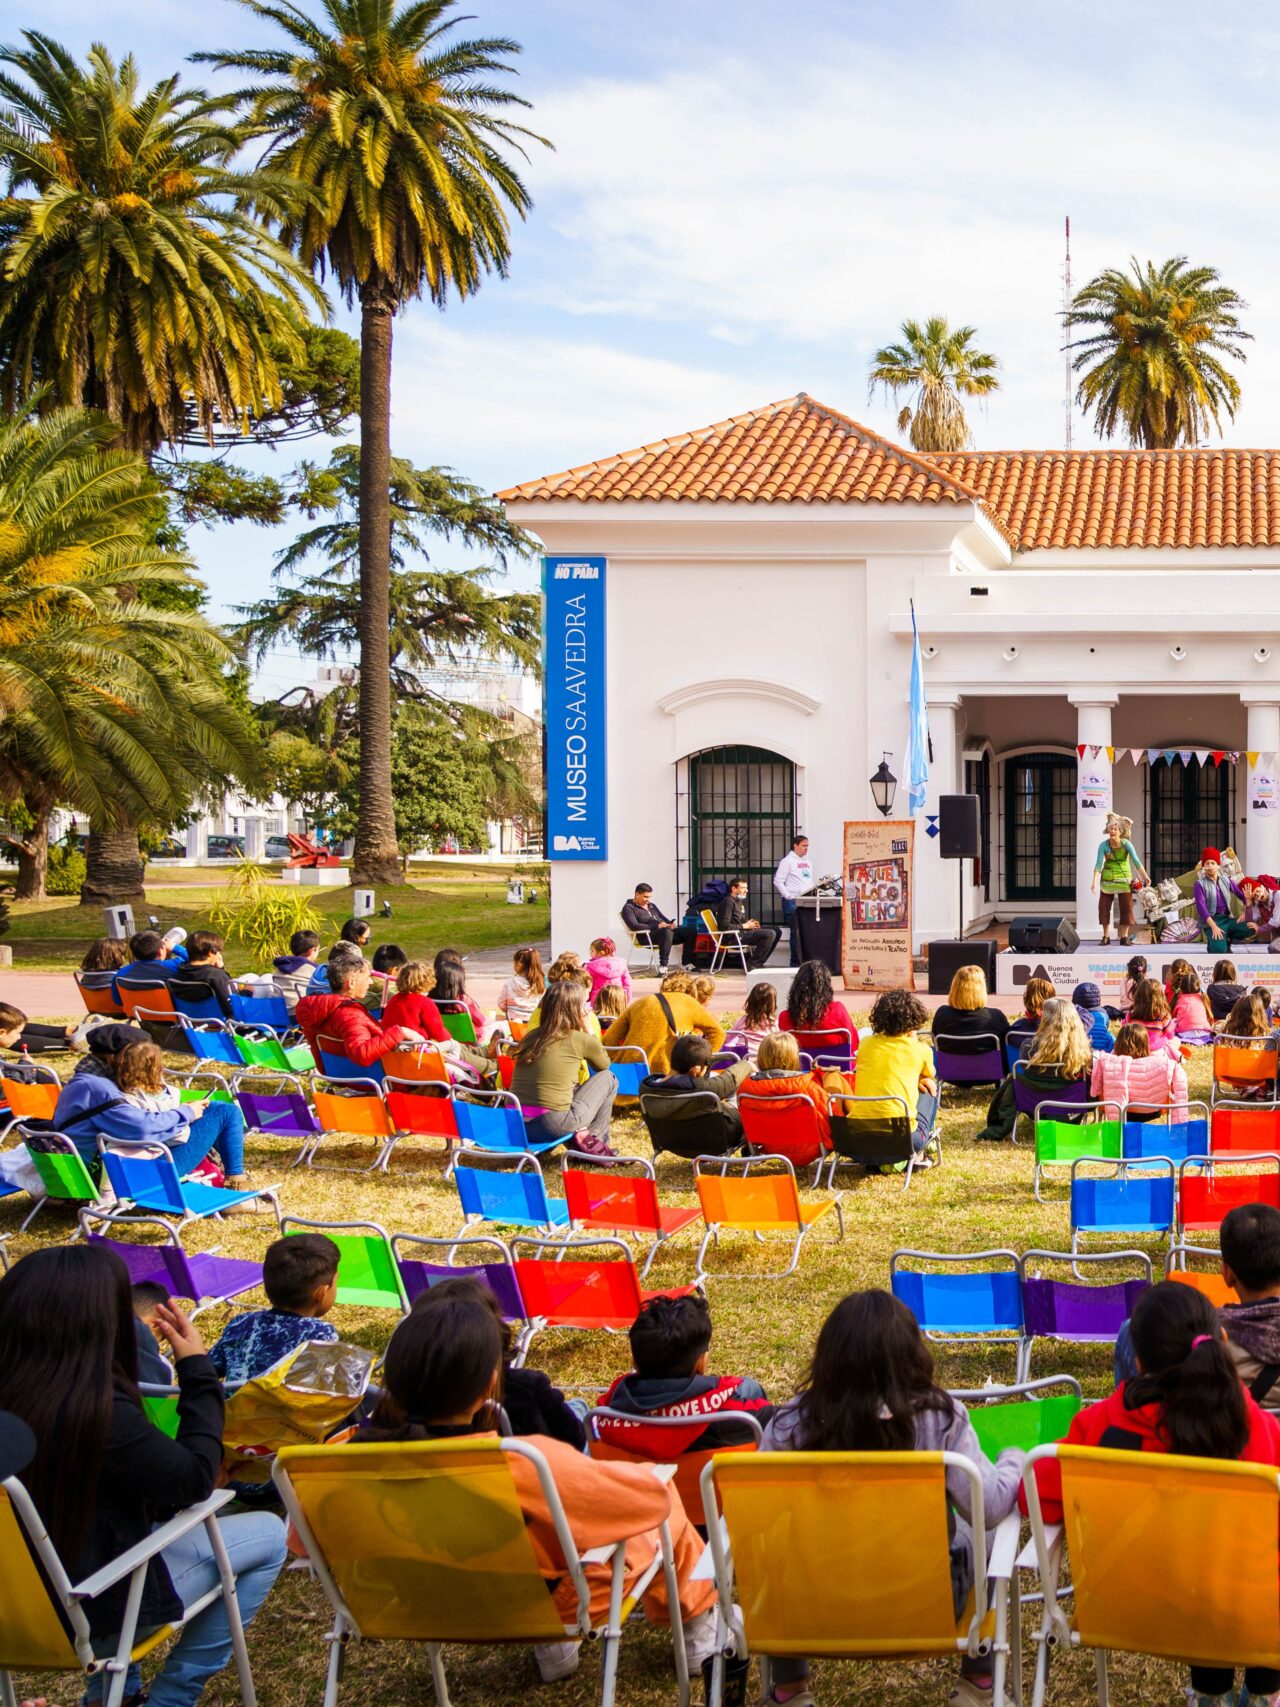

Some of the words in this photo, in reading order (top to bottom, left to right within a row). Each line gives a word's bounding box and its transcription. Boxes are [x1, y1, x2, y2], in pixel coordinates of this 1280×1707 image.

[554, 567, 570, 579] NO
[572, 567, 599, 579] PARA
[565, 593, 587, 731] SAAVEDRA
[566, 735, 587, 822] MUSEO
[1081, 799, 1097, 809] BA
[1252, 800, 1269, 810] BA
[553, 835, 581, 851] BA
